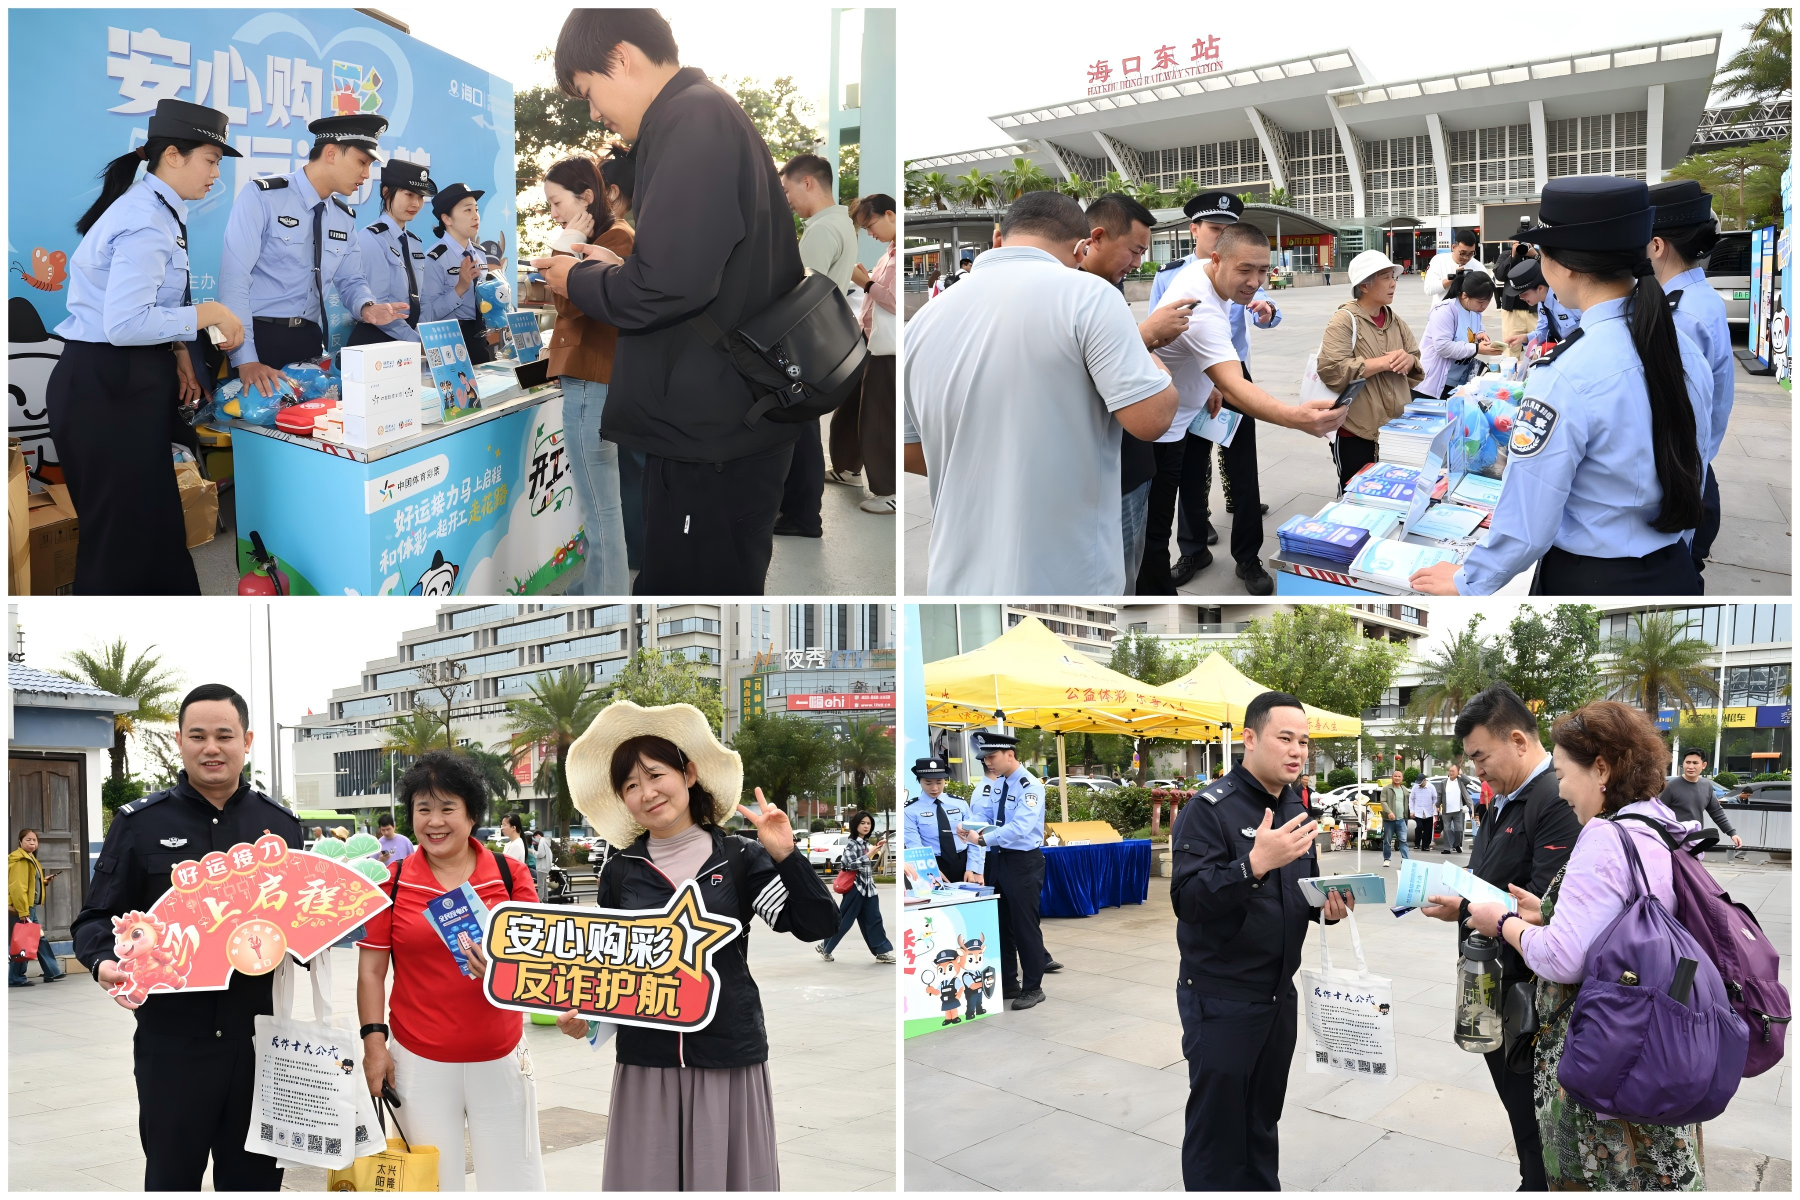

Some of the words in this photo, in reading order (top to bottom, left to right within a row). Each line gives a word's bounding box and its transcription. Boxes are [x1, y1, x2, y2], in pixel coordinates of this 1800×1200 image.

[1087, 34, 1221, 84] 海口东站
[1144, 68, 1184, 86] RAILWAY
[1184, 60, 1224, 80] STATION
[461, 82, 483, 108] 海口
[397, 465, 440, 492] 中国体育彩票
[393, 464, 502, 538] 好运接力马上启程
[785, 646, 826, 670] 夜秀
[828, 650, 869, 669] KTV
[1065, 687, 1127, 704] 公益体彩
[177, 840, 282, 887] 好运接力
[505, 914, 673, 969] 安心购彩
[512, 962, 681, 1018] 反诈护航
[1314, 986, 1376, 1006] 反诈十大公式
[271, 1035, 339, 1061] 反诈十大公式
[386, 1164, 397, 1192] 兴隆
